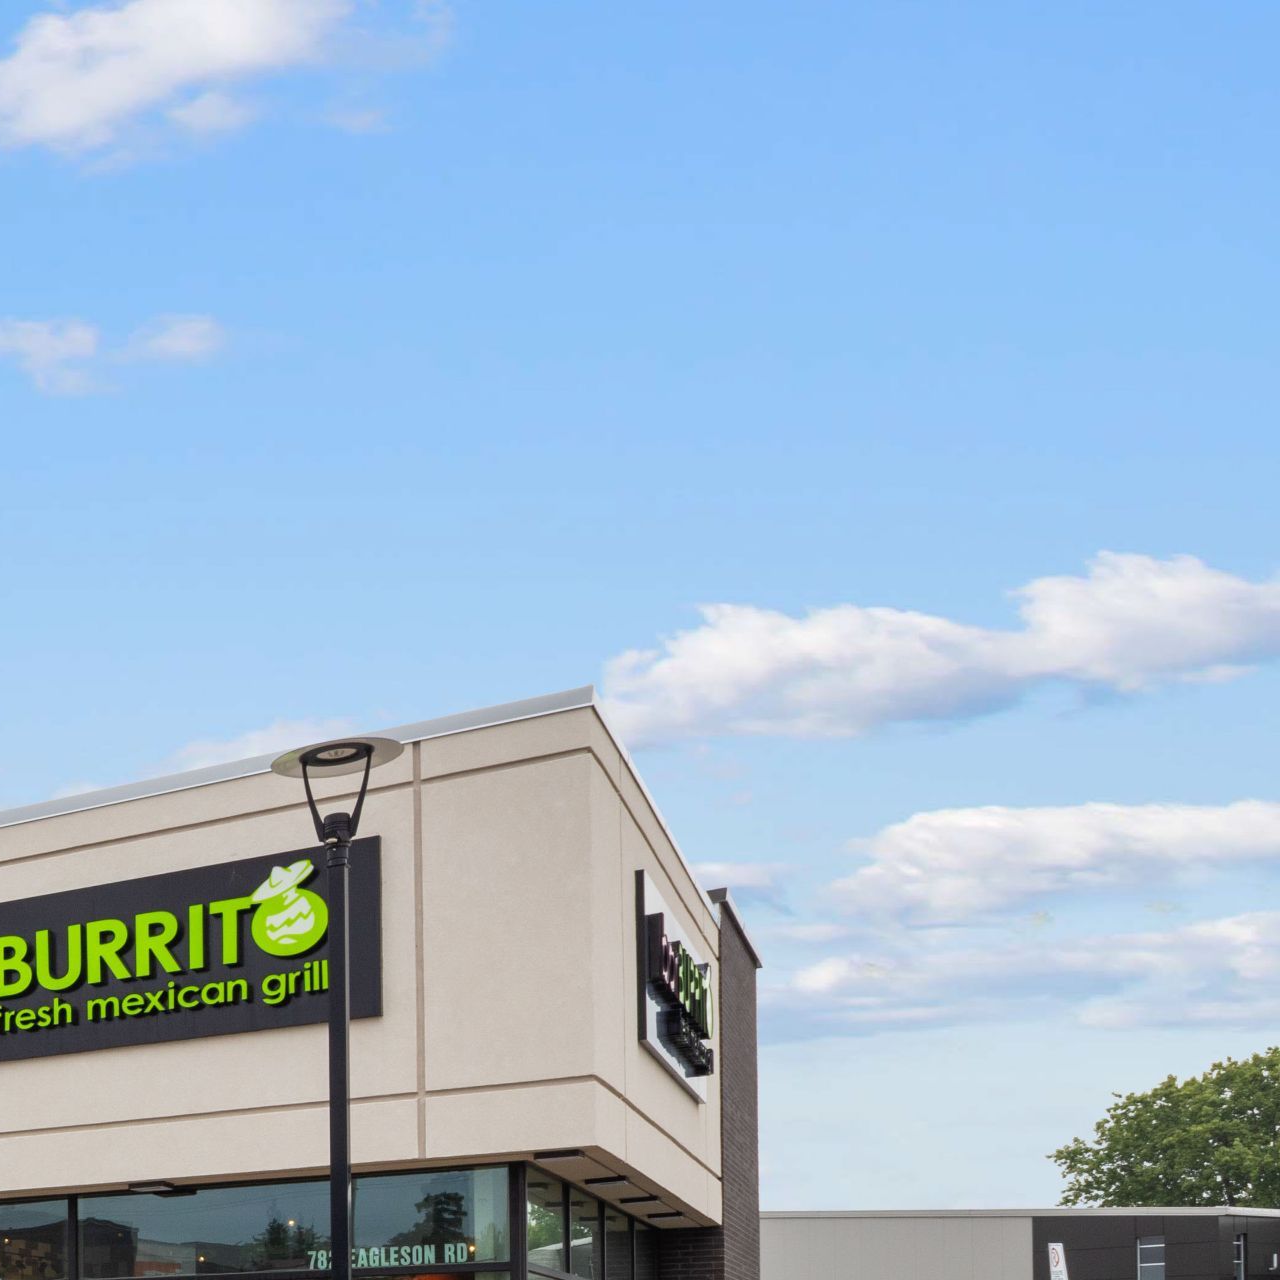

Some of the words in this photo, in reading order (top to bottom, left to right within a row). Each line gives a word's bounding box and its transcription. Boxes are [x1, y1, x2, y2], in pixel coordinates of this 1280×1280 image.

[86, 976, 248, 1023] mexican
[261, 959, 329, 1005] grill
[444, 1242, 468, 1263] RD
